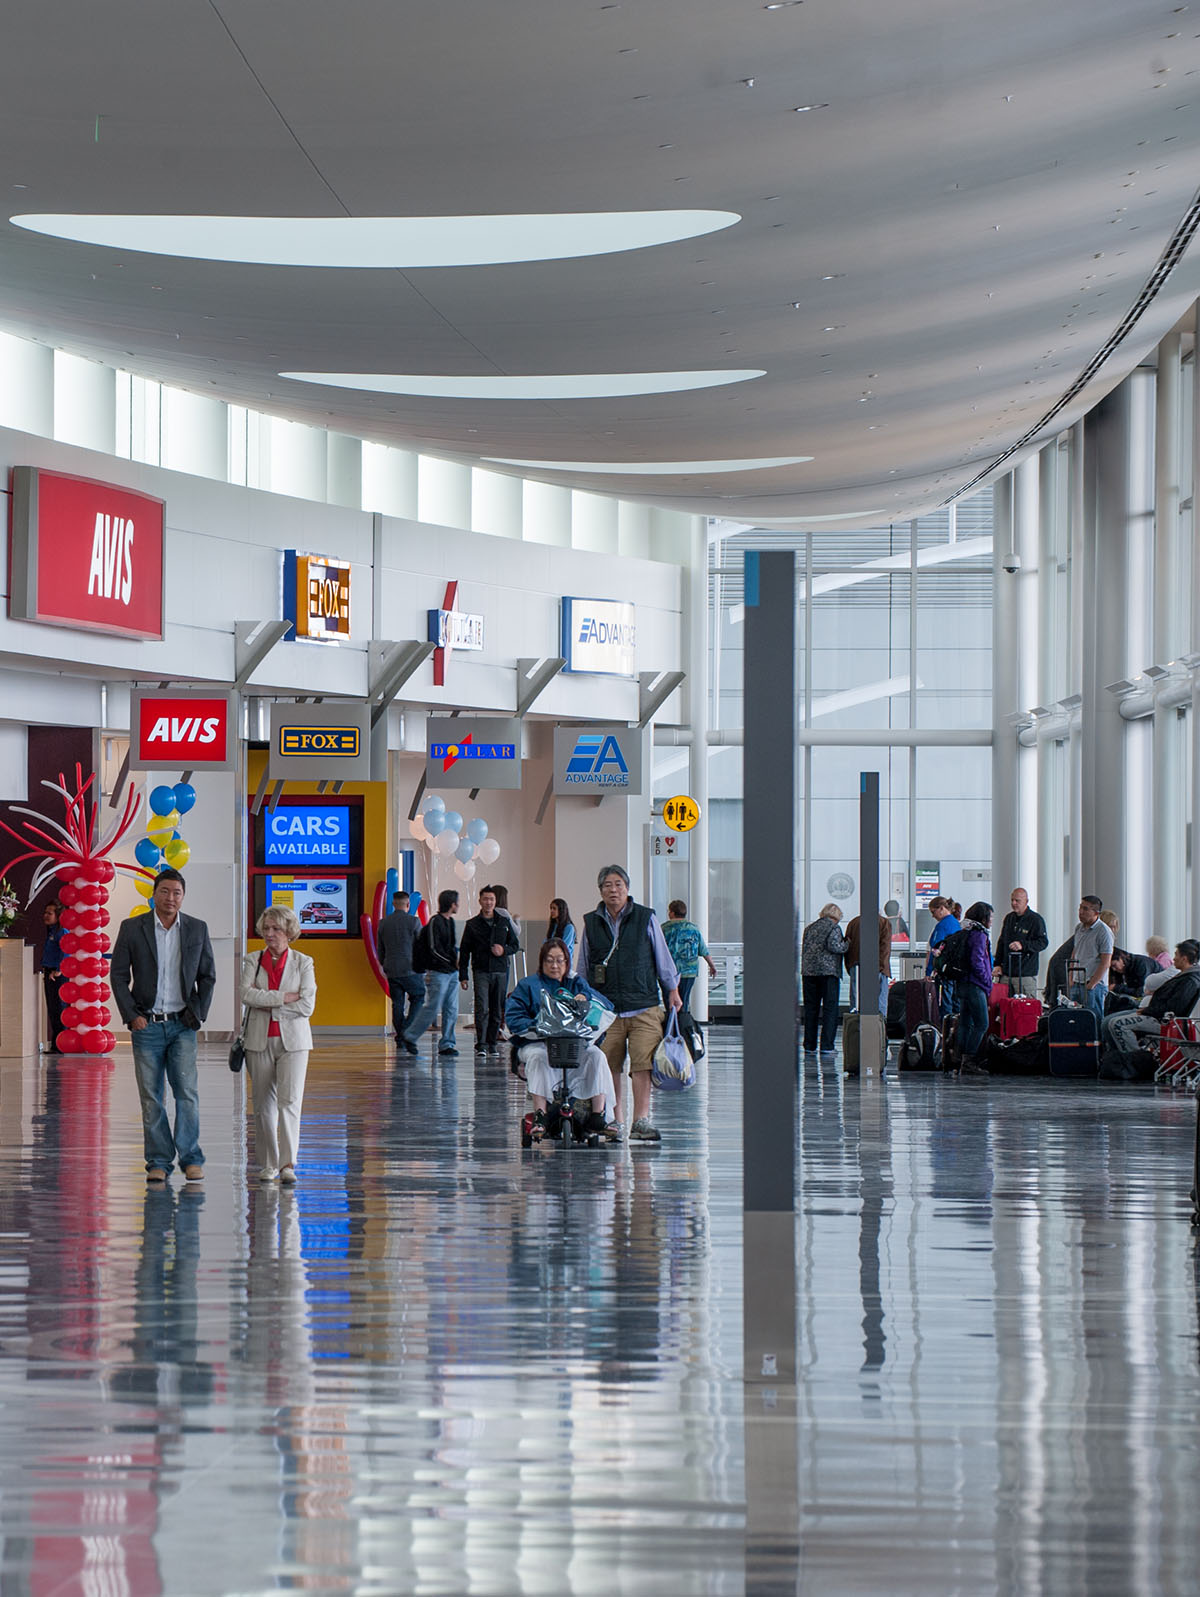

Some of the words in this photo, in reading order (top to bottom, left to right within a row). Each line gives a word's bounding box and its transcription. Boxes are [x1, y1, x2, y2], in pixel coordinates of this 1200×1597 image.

[87, 512, 135, 606] AVIS
[318, 578, 341, 619] FOX
[148, 717, 220, 744] AVIS
[300, 734, 339, 749] FOX
[434, 744, 511, 757] DOLLAR
[565, 773, 629, 783] ADVANTAGE
[271, 815, 341, 836] CARS
[268, 843, 347, 855] AVAILABLE
